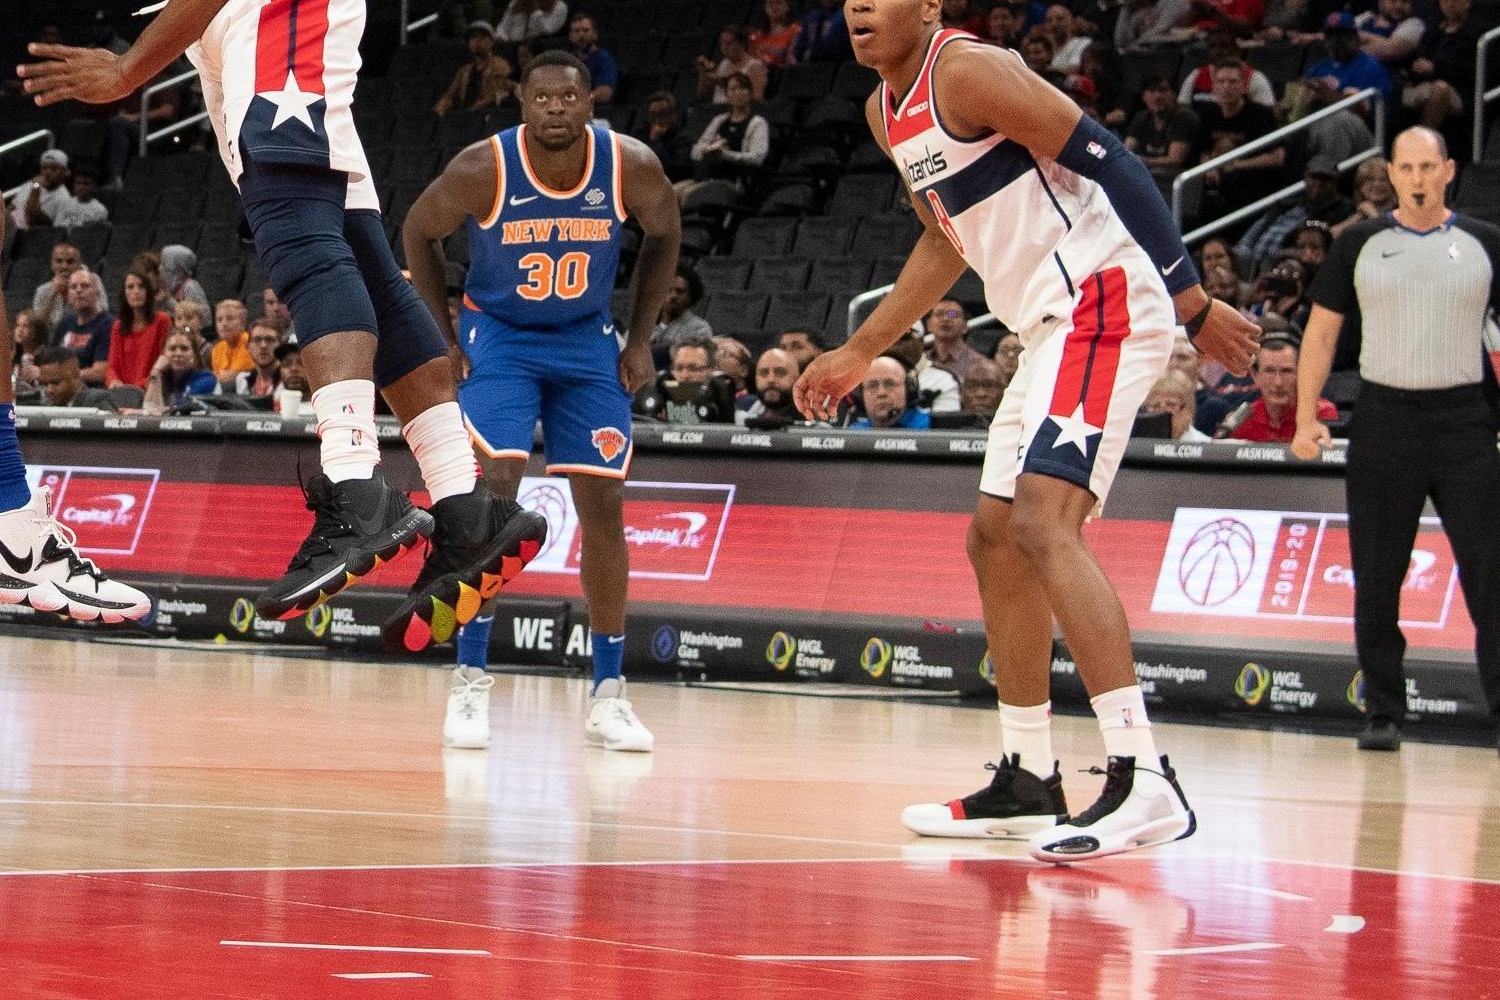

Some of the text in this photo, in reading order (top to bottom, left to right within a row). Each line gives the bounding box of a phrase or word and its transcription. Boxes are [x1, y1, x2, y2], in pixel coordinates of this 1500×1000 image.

[501, 217, 613, 245] NEW YORK
[516, 251, 591, 301] 30
[662, 431, 704, 445] WGL.COM
[801, 437, 845, 450] WGL.COM
[1153, 443, 1203, 458] WGL.COM
[1271, 523, 1309, 608] 2019-20
[158, 598, 207, 618] Washington
[513, 616, 555, 651] WE
[678, 629, 744, 651] Washington
[677, 644, 701, 661] Gas
[797, 638, 826, 656] WGL
[892, 644, 922, 662] WGL
[795, 653, 837, 674] Energy
[891, 660, 955, 680] Midstream
[1133, 661, 1208, 684] Washington
[1272, 670, 1304, 688] WGL
[1270, 686, 1319, 708] Energy
